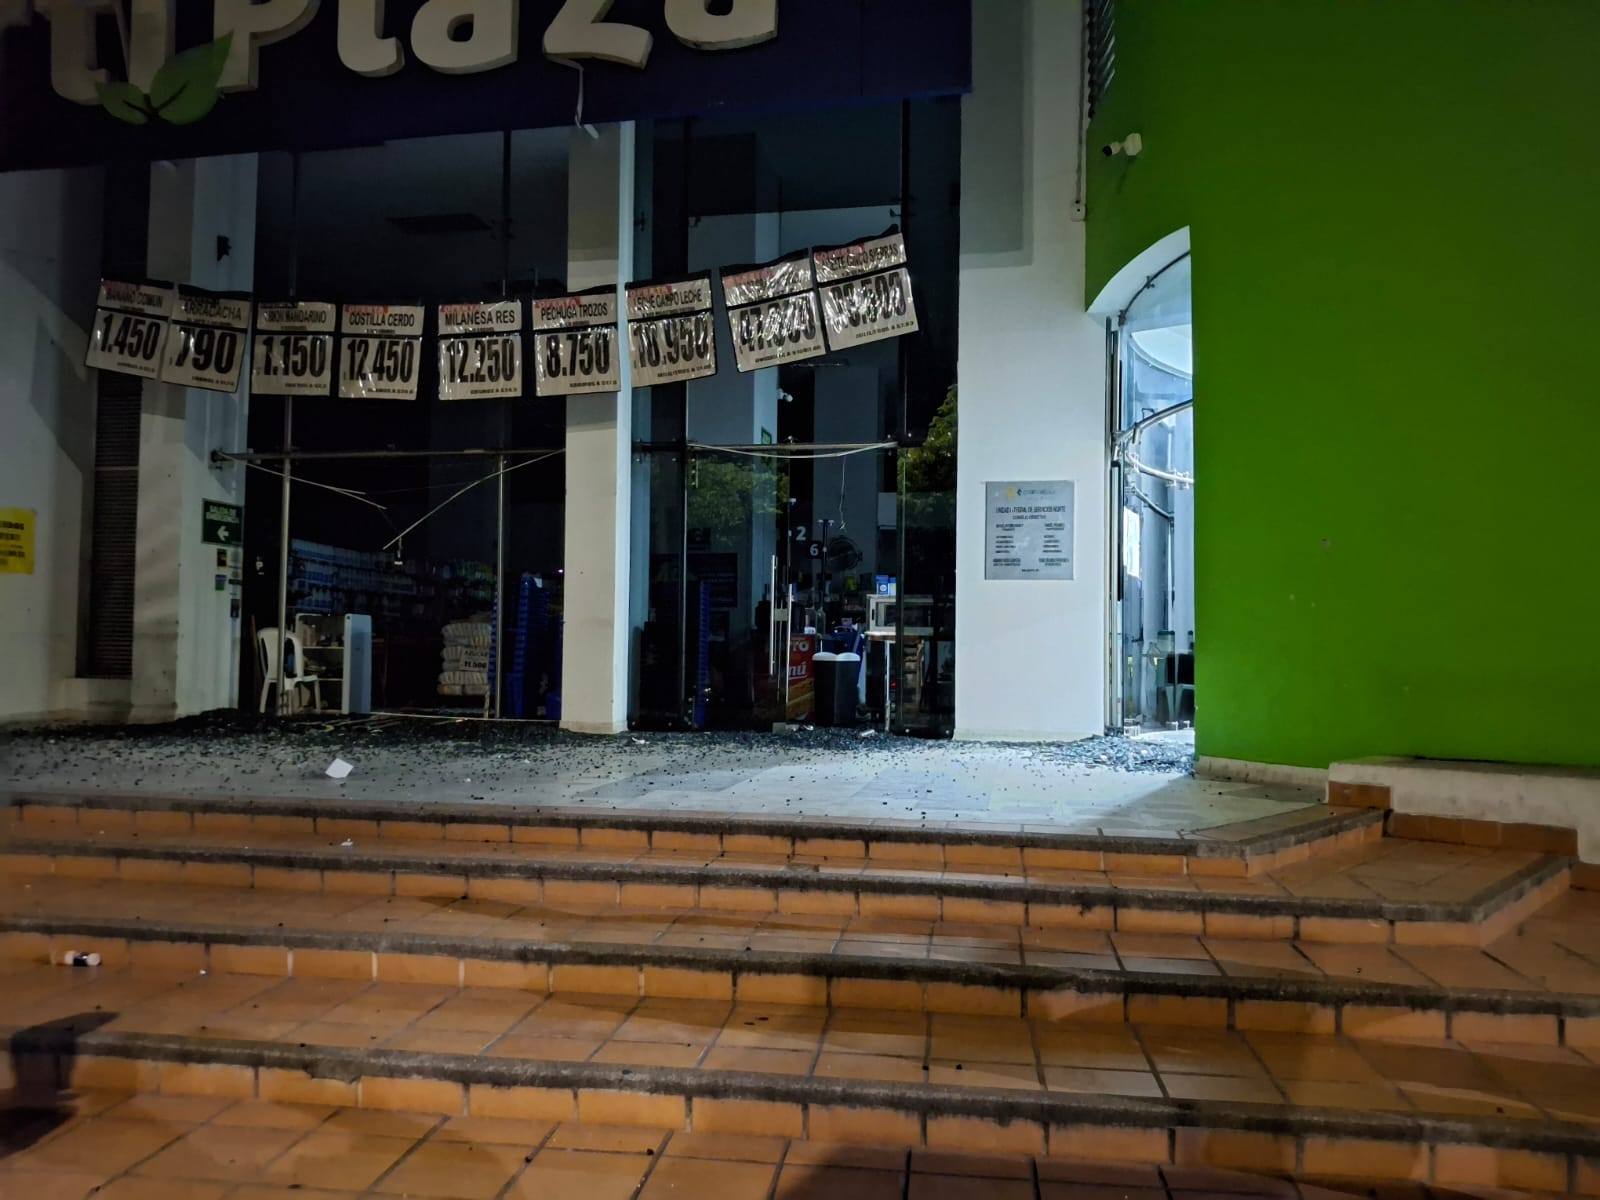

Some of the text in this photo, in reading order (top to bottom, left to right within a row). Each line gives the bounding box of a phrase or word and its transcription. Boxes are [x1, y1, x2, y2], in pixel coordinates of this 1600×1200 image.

[348, 310, 416, 328] COSTILLA CERDO
[445, 309, 516, 326] MILANESA RES
[540, 305, 578, 321] PECHUGA
[578, 302, 609, 318] TROZOS
[100, 313, 161, 361] 1.450
[176, 326, 238, 375] 790
[262, 336, 327, 378] 1.150
[447, 338, 515, 384] 12.250
[546, 333, 610, 379] 8.750
[796, 526, 807, 541] 2
[809, 544, 820, 557] 6
